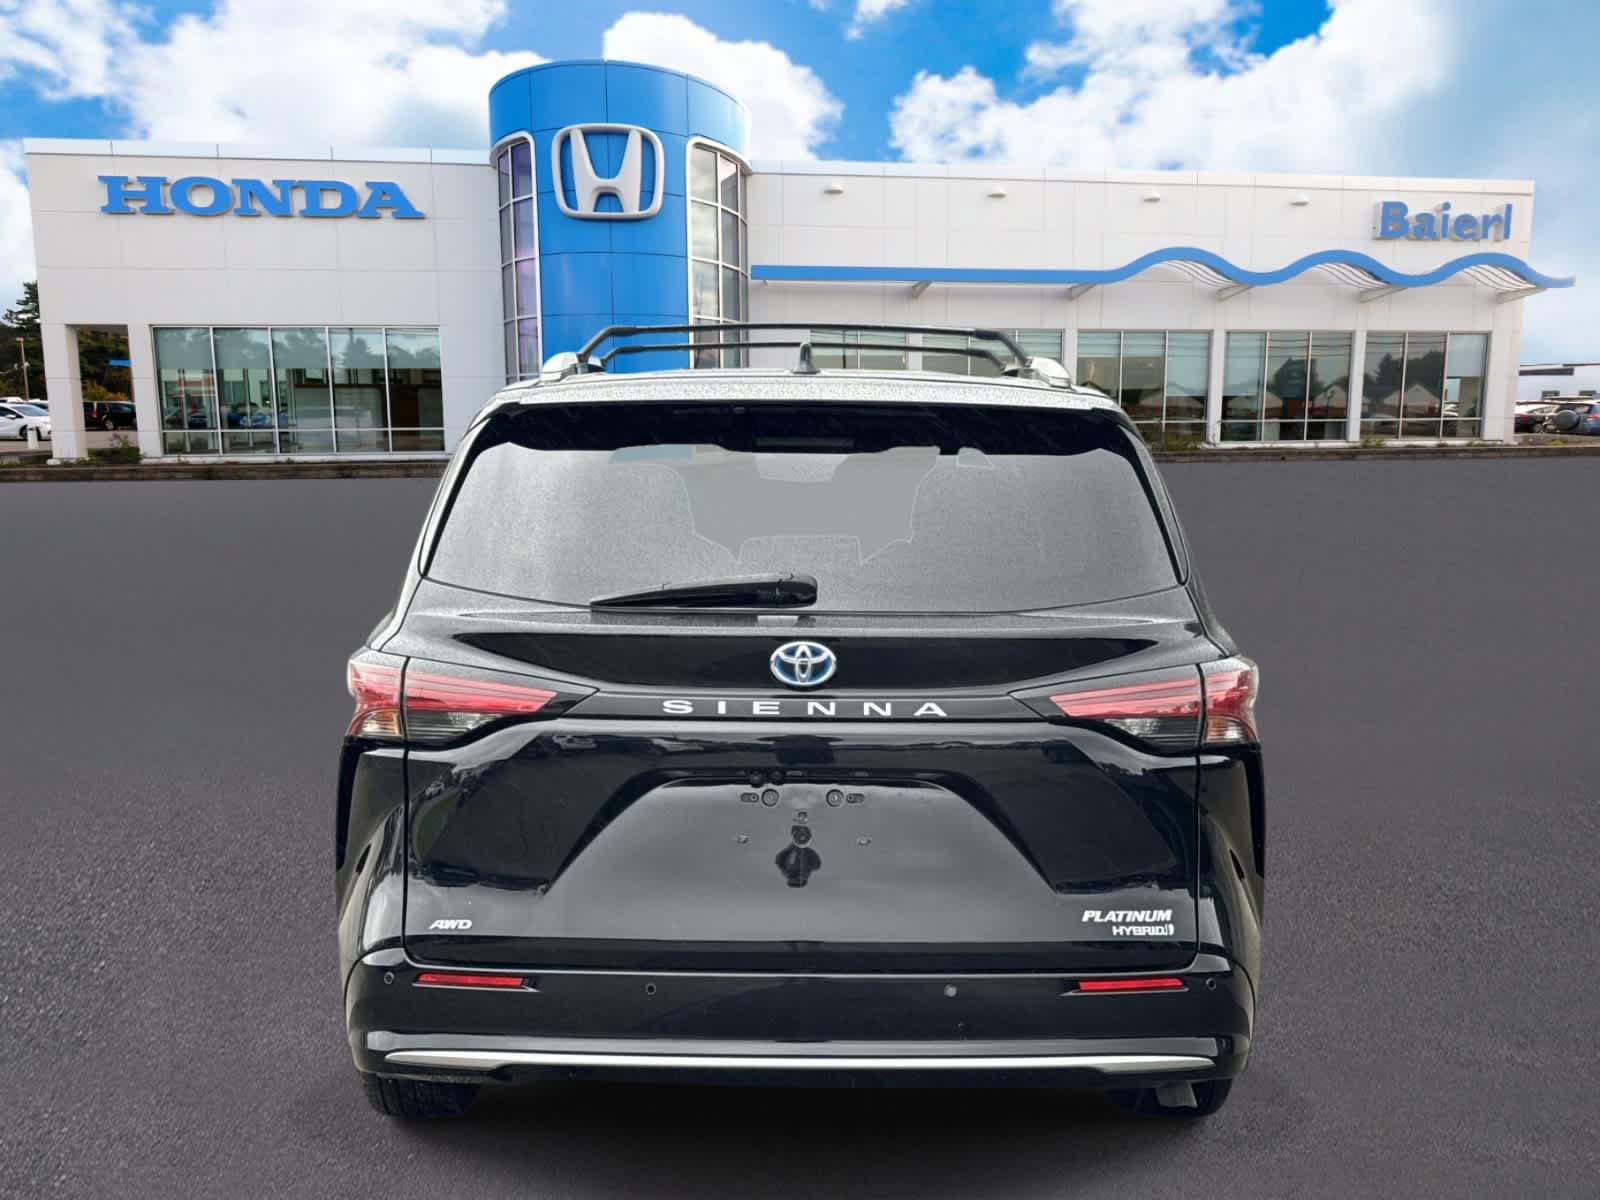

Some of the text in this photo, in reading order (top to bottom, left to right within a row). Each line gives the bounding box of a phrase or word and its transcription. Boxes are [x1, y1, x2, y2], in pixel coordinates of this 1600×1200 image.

[97, 175, 425, 219] HONDA
[1379, 200, 1513, 240] Baierl
[662, 699, 948, 718] SIENNA
[1081, 909, 1173, 923] PLATINUM
[427, 919, 473, 930] AWD
[1112, 925, 1165, 936] HYBRID
